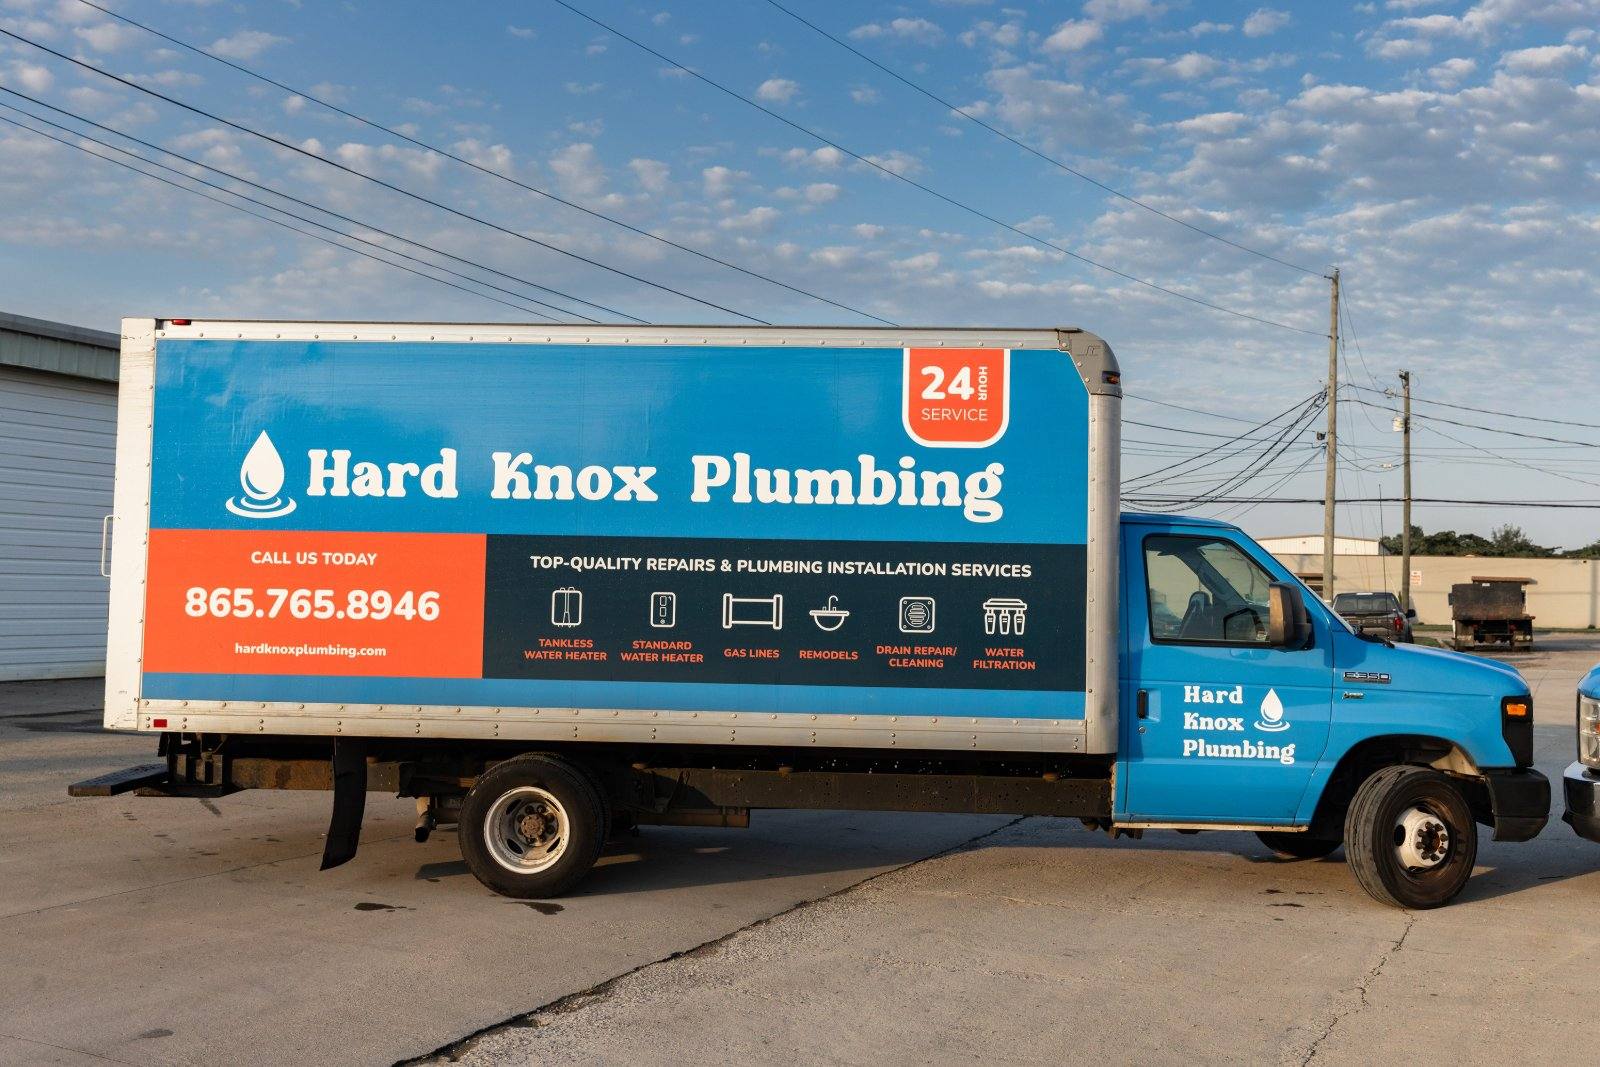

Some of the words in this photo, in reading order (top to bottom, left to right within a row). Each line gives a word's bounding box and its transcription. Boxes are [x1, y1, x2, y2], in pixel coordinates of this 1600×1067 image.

[921, 366, 974, 400] 24
[978, 367, 987, 400] HOUR
[922, 408, 987, 421] SERVICE
[307, 448, 458, 498] Hard
[491, 452, 658, 501] Knox
[691, 453, 1004, 523] Plumbing
[251, 551, 291, 564] CALL
[296, 552, 317, 564] US
[322, 552, 377, 565] TODAY
[530, 556, 641, 572] TOP-QUALITY
[647, 558, 715, 571] REPAIRS
[721, 559, 731, 571] &
[738, 560, 822, 573] PLUMBING
[828, 562, 946, 575] INSTALLATION
[952, 564, 1031, 577] SERVICES
[185, 587, 440, 621] 865.765.8946
[235, 643, 386, 658] hardknoxplumbing.com
[539, 639, 593, 649] TANKLESS
[633, 641, 691, 650] STANDARD
[877, 646, 911, 654] DRAIN
[914, 647, 957, 655] REPAIR/
[525, 650, 562, 659] WATER
[566, 652, 607, 660] HEATER
[621, 653, 658, 661] WATER
[662, 654, 703, 662] HEATER
[724, 649, 746, 657] GAS
[750, 649, 779, 658] LINES
[800, 651, 858, 660] REMODELS
[986, 648, 1023, 657] WATER
[889, 659, 943, 667] CLEANING
[974, 660, 1035, 669] FILTRATION
[1184, 686, 1243, 704] Hard
[1184, 713, 1244, 731] Knox
[1183, 739, 1295, 764] Plumbing
